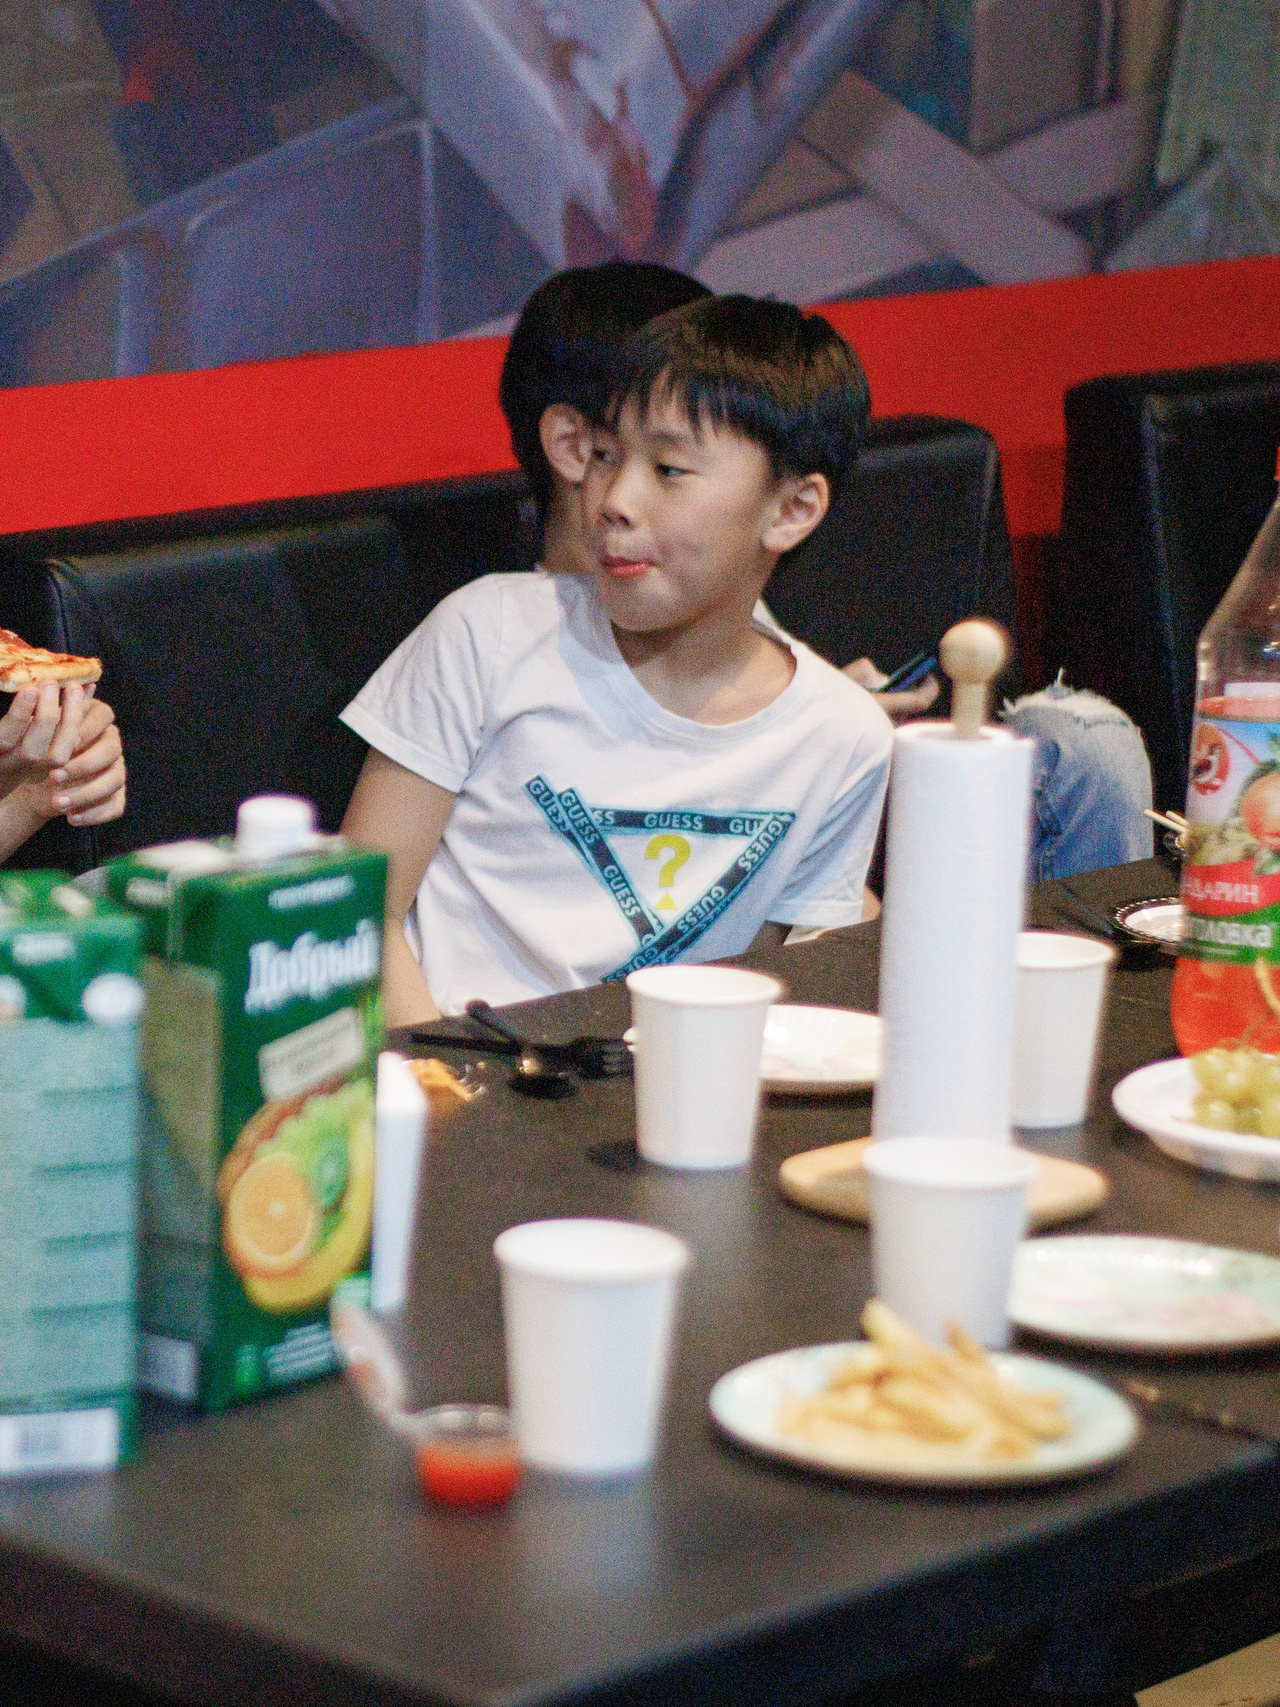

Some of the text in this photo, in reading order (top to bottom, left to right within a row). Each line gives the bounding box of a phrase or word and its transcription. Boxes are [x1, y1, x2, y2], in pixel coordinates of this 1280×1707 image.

[561, 792, 600, 843] GUESS
[644, 812, 703, 832] GUESS
[737, 820, 783, 872] GUESS
[604, 865, 640, 917] GUESS
[677, 885, 725, 933] GUESS
[245, 918, 380, 1014] Добрый
